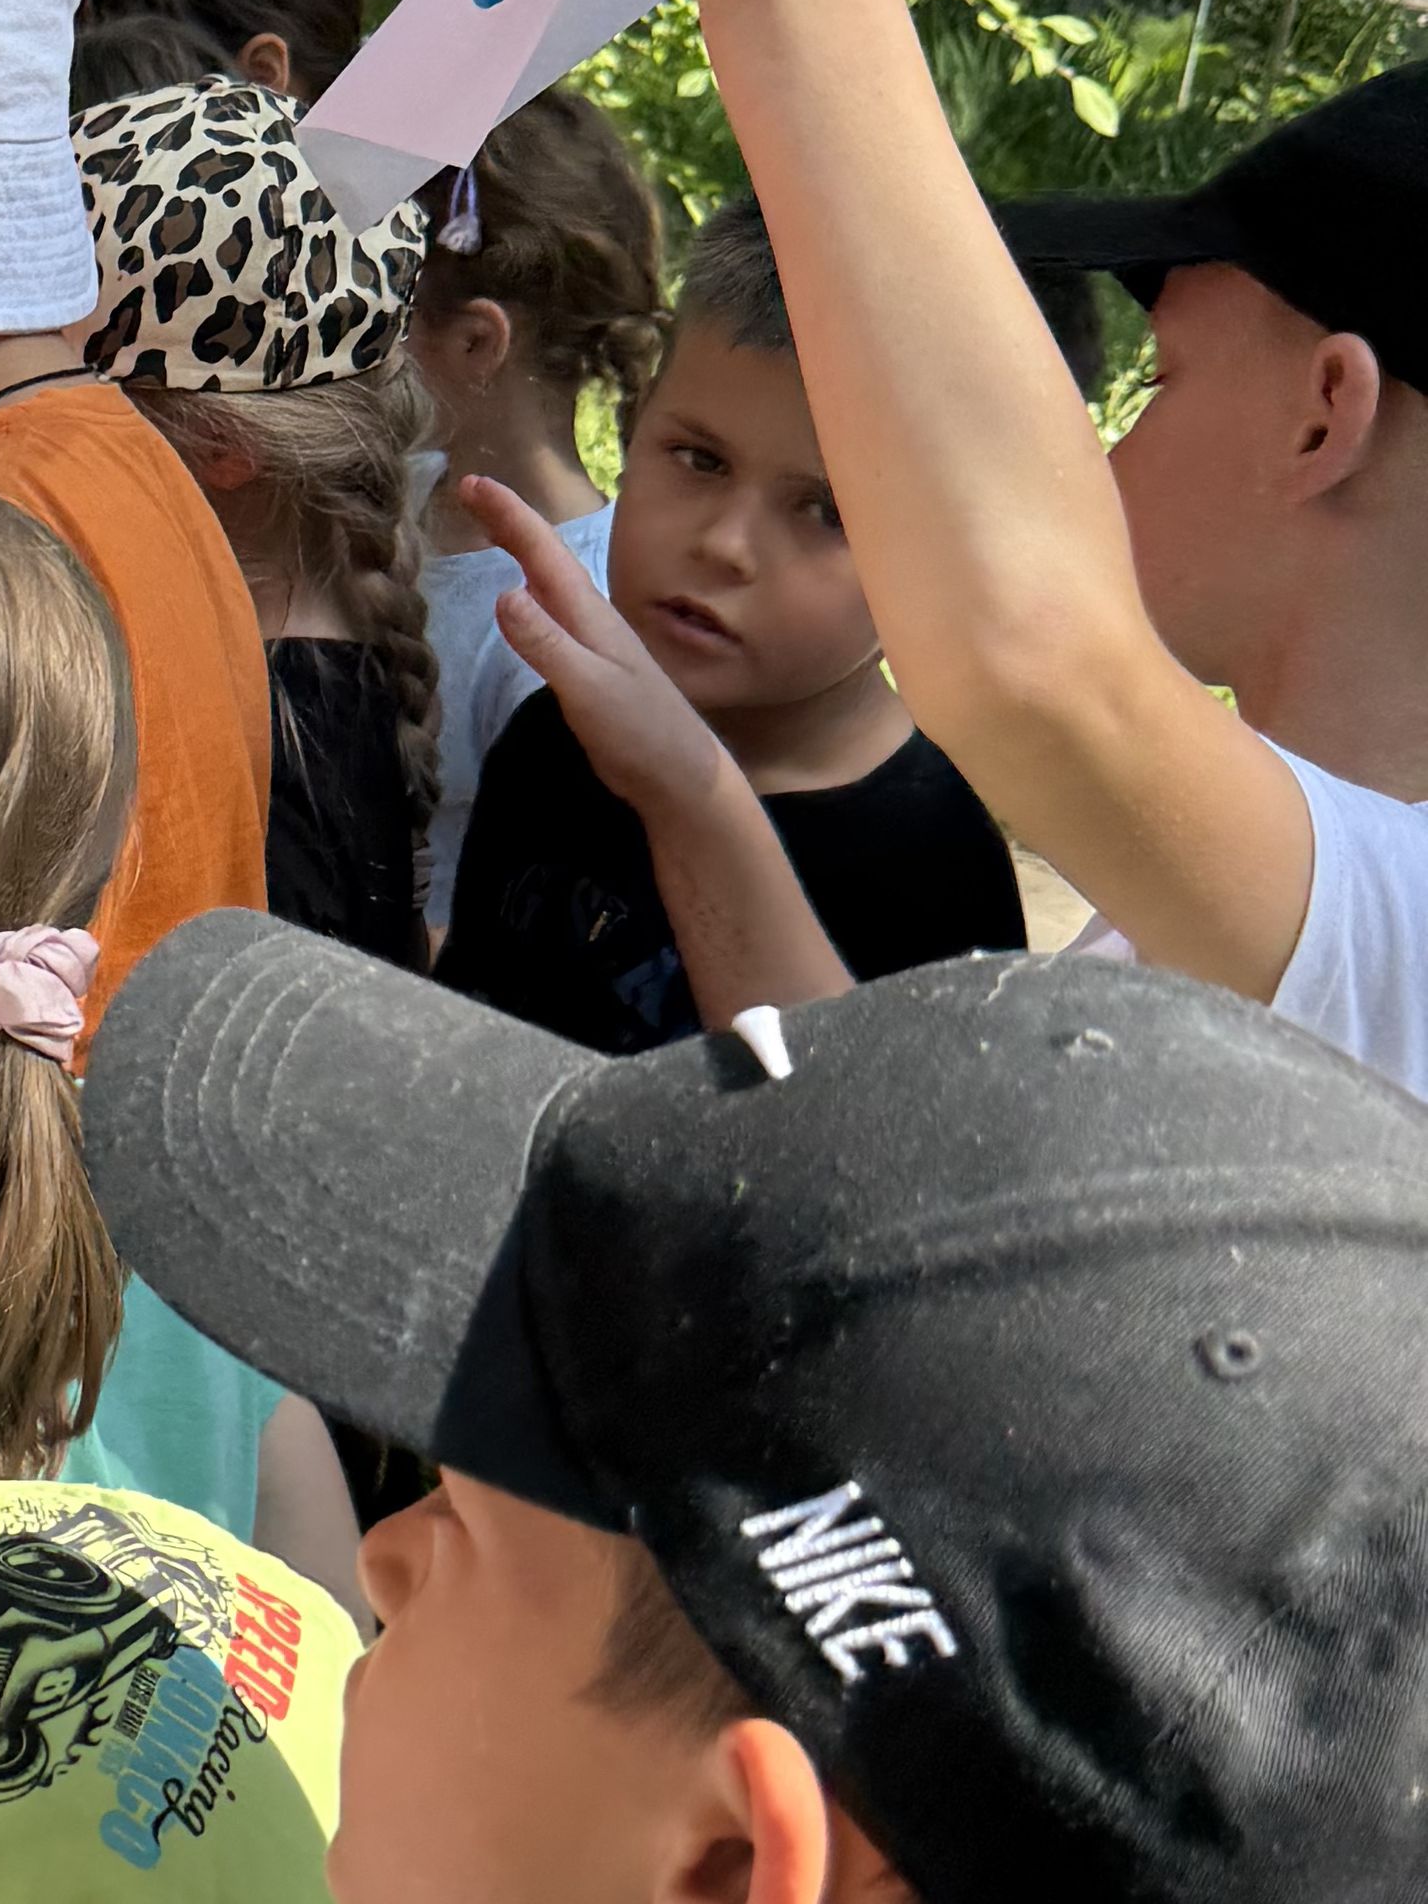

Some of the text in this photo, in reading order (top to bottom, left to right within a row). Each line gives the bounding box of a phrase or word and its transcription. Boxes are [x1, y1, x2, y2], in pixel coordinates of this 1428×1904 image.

[739, 1478, 958, 1685] NIKE
[99, 1644, 232, 1871] MONACO
[152, 1572, 302, 1847] SPEED Racing
